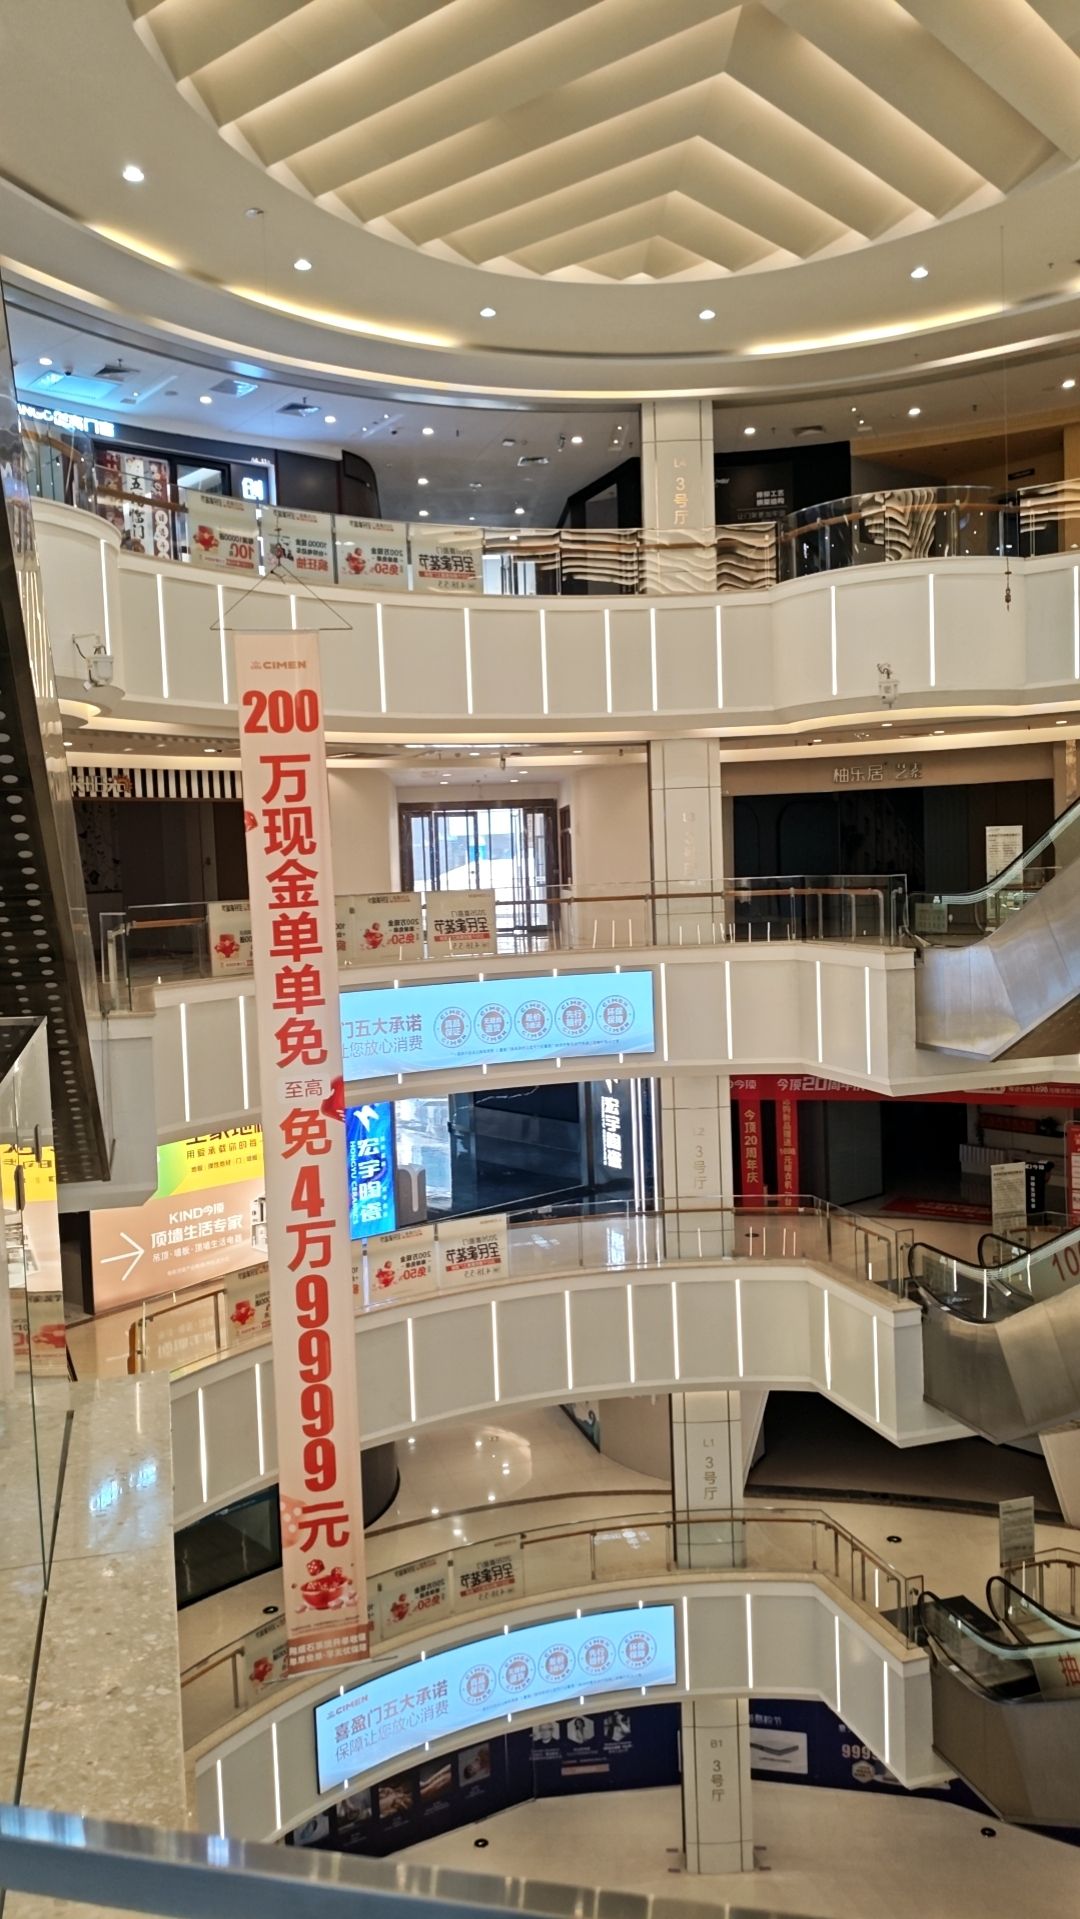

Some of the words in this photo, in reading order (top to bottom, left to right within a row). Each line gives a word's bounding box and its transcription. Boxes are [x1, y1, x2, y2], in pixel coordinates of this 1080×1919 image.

[129, 477, 145, 539] 五临门
[263, 661, 307, 669] CIMEN
[833, 765, 883, 783] 柚乐居
[284, 1079, 324, 1099] 至高
[743, 1109, 759, 1184] 今顶20周年庆
[151, 1214, 244, 1249] 顶墙生活专家
[1053, 1241, 1080, 1282] 10
[704, 1456, 717, 1500] 3号厅
[334, 1680, 449, 1743] 喜盈门五大承诺
[335, 1700, 449, 1762] 保障让您放心消费
[711, 1760, 725, 1802] 3号厅
